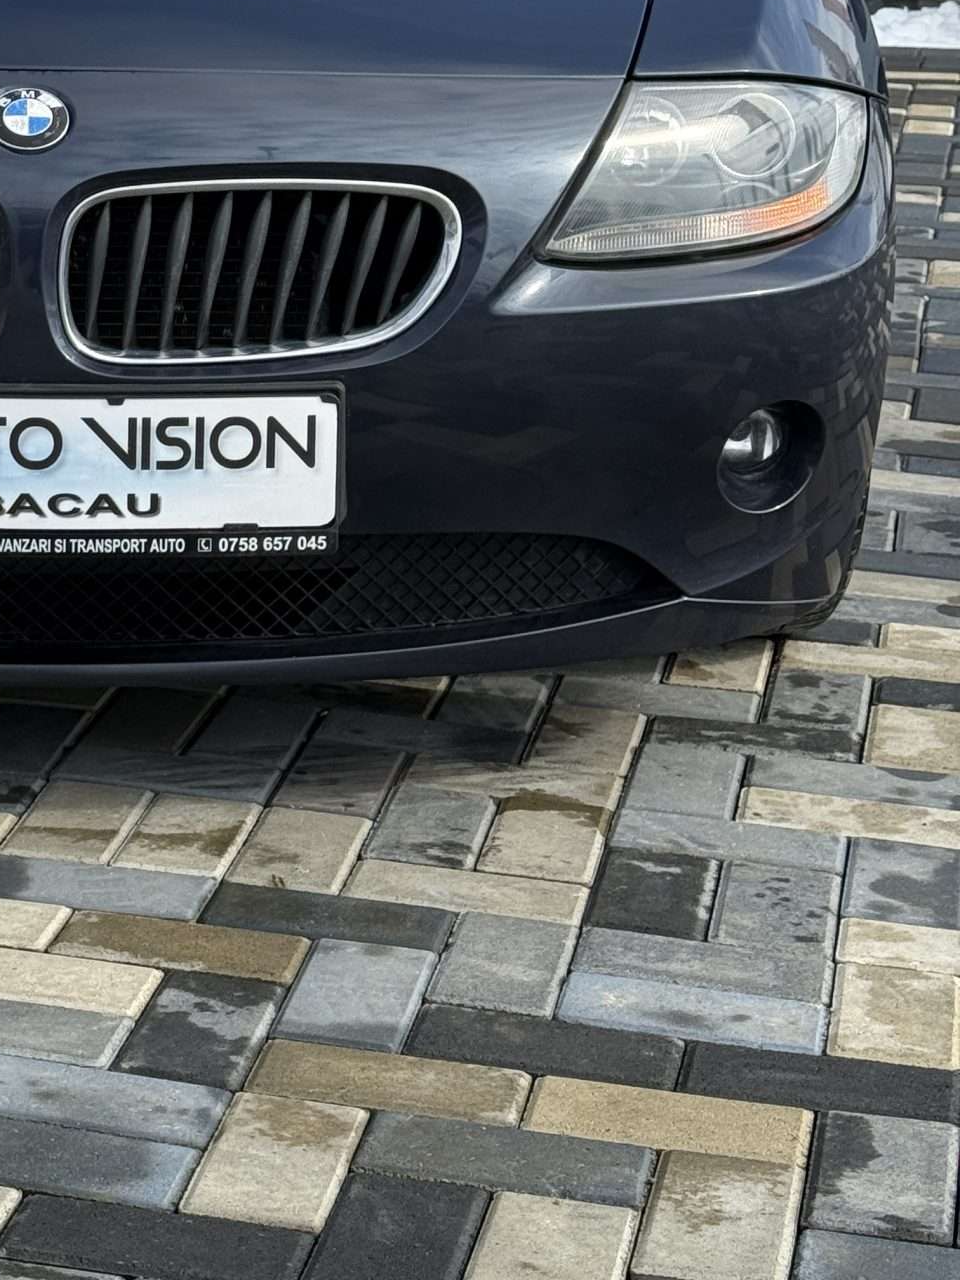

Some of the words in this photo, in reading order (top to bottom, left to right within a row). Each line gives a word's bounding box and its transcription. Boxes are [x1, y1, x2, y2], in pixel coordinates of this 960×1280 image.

[81, 414, 317, 471] VISION
[54, 538, 67, 553] SI
[69, 538, 147, 553] TRANSPORT
[150, 538, 186, 553] AUTO
[218, 536, 258, 553] 0758
[262, 536, 293, 552] 657
[297, 535, 327, 551] 045
